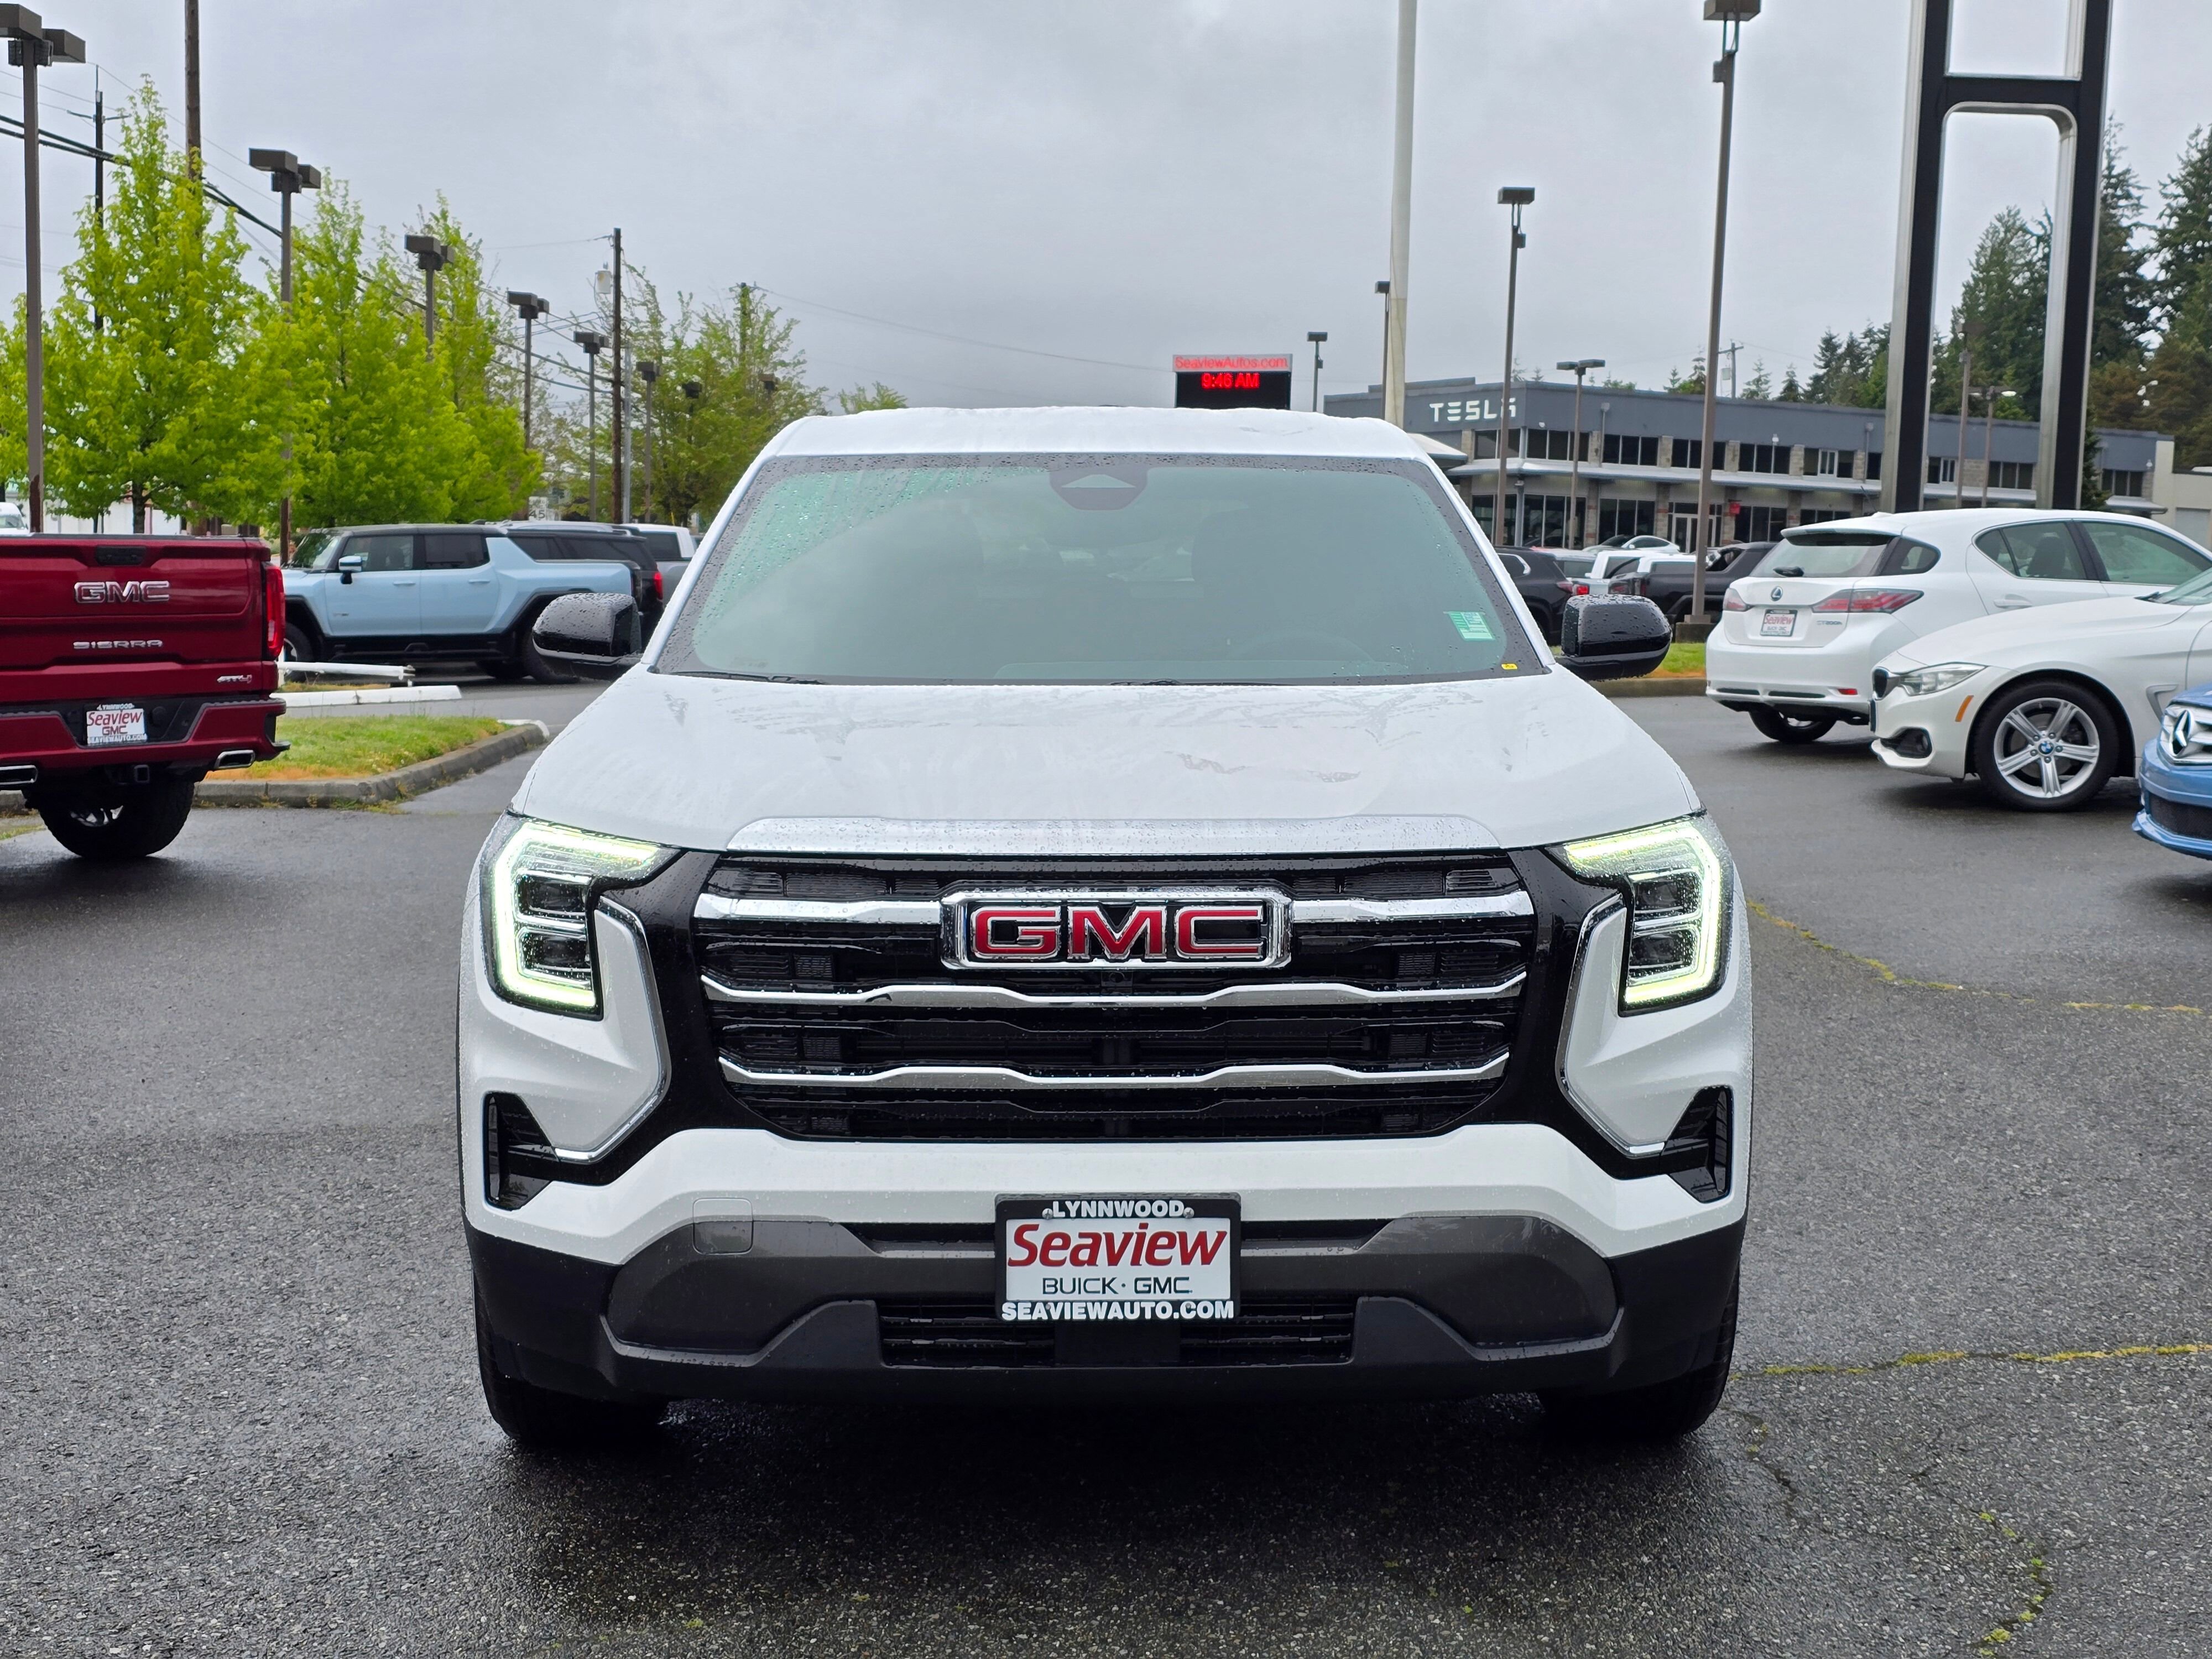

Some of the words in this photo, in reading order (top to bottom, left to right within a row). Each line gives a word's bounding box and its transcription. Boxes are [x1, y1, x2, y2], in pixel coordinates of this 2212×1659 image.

[1175, 356, 1288, 369] SeaviewAutos.com
[1202, 372, 1233, 388] 9:46
[1234, 372, 1260, 388] AM
[529, 510, 545, 519] 45
[74, 581, 170, 603] GMC
[73, 639, 163, 649] SIERRA
[87, 710, 143, 726] Seaview
[102, 725, 128, 735] GMC
[970, 905, 1264, 961] GMC
[1052, 1200, 1185, 1218] LYNNWOOD
[1007, 1222, 1228, 1267] Seaview
[1042, 1277, 1119, 1295] BUICK
[1134, 1276, 1192, 1295] GMC
[1001, 1300, 1234, 1321] SEAVIEWAUTO.COM
